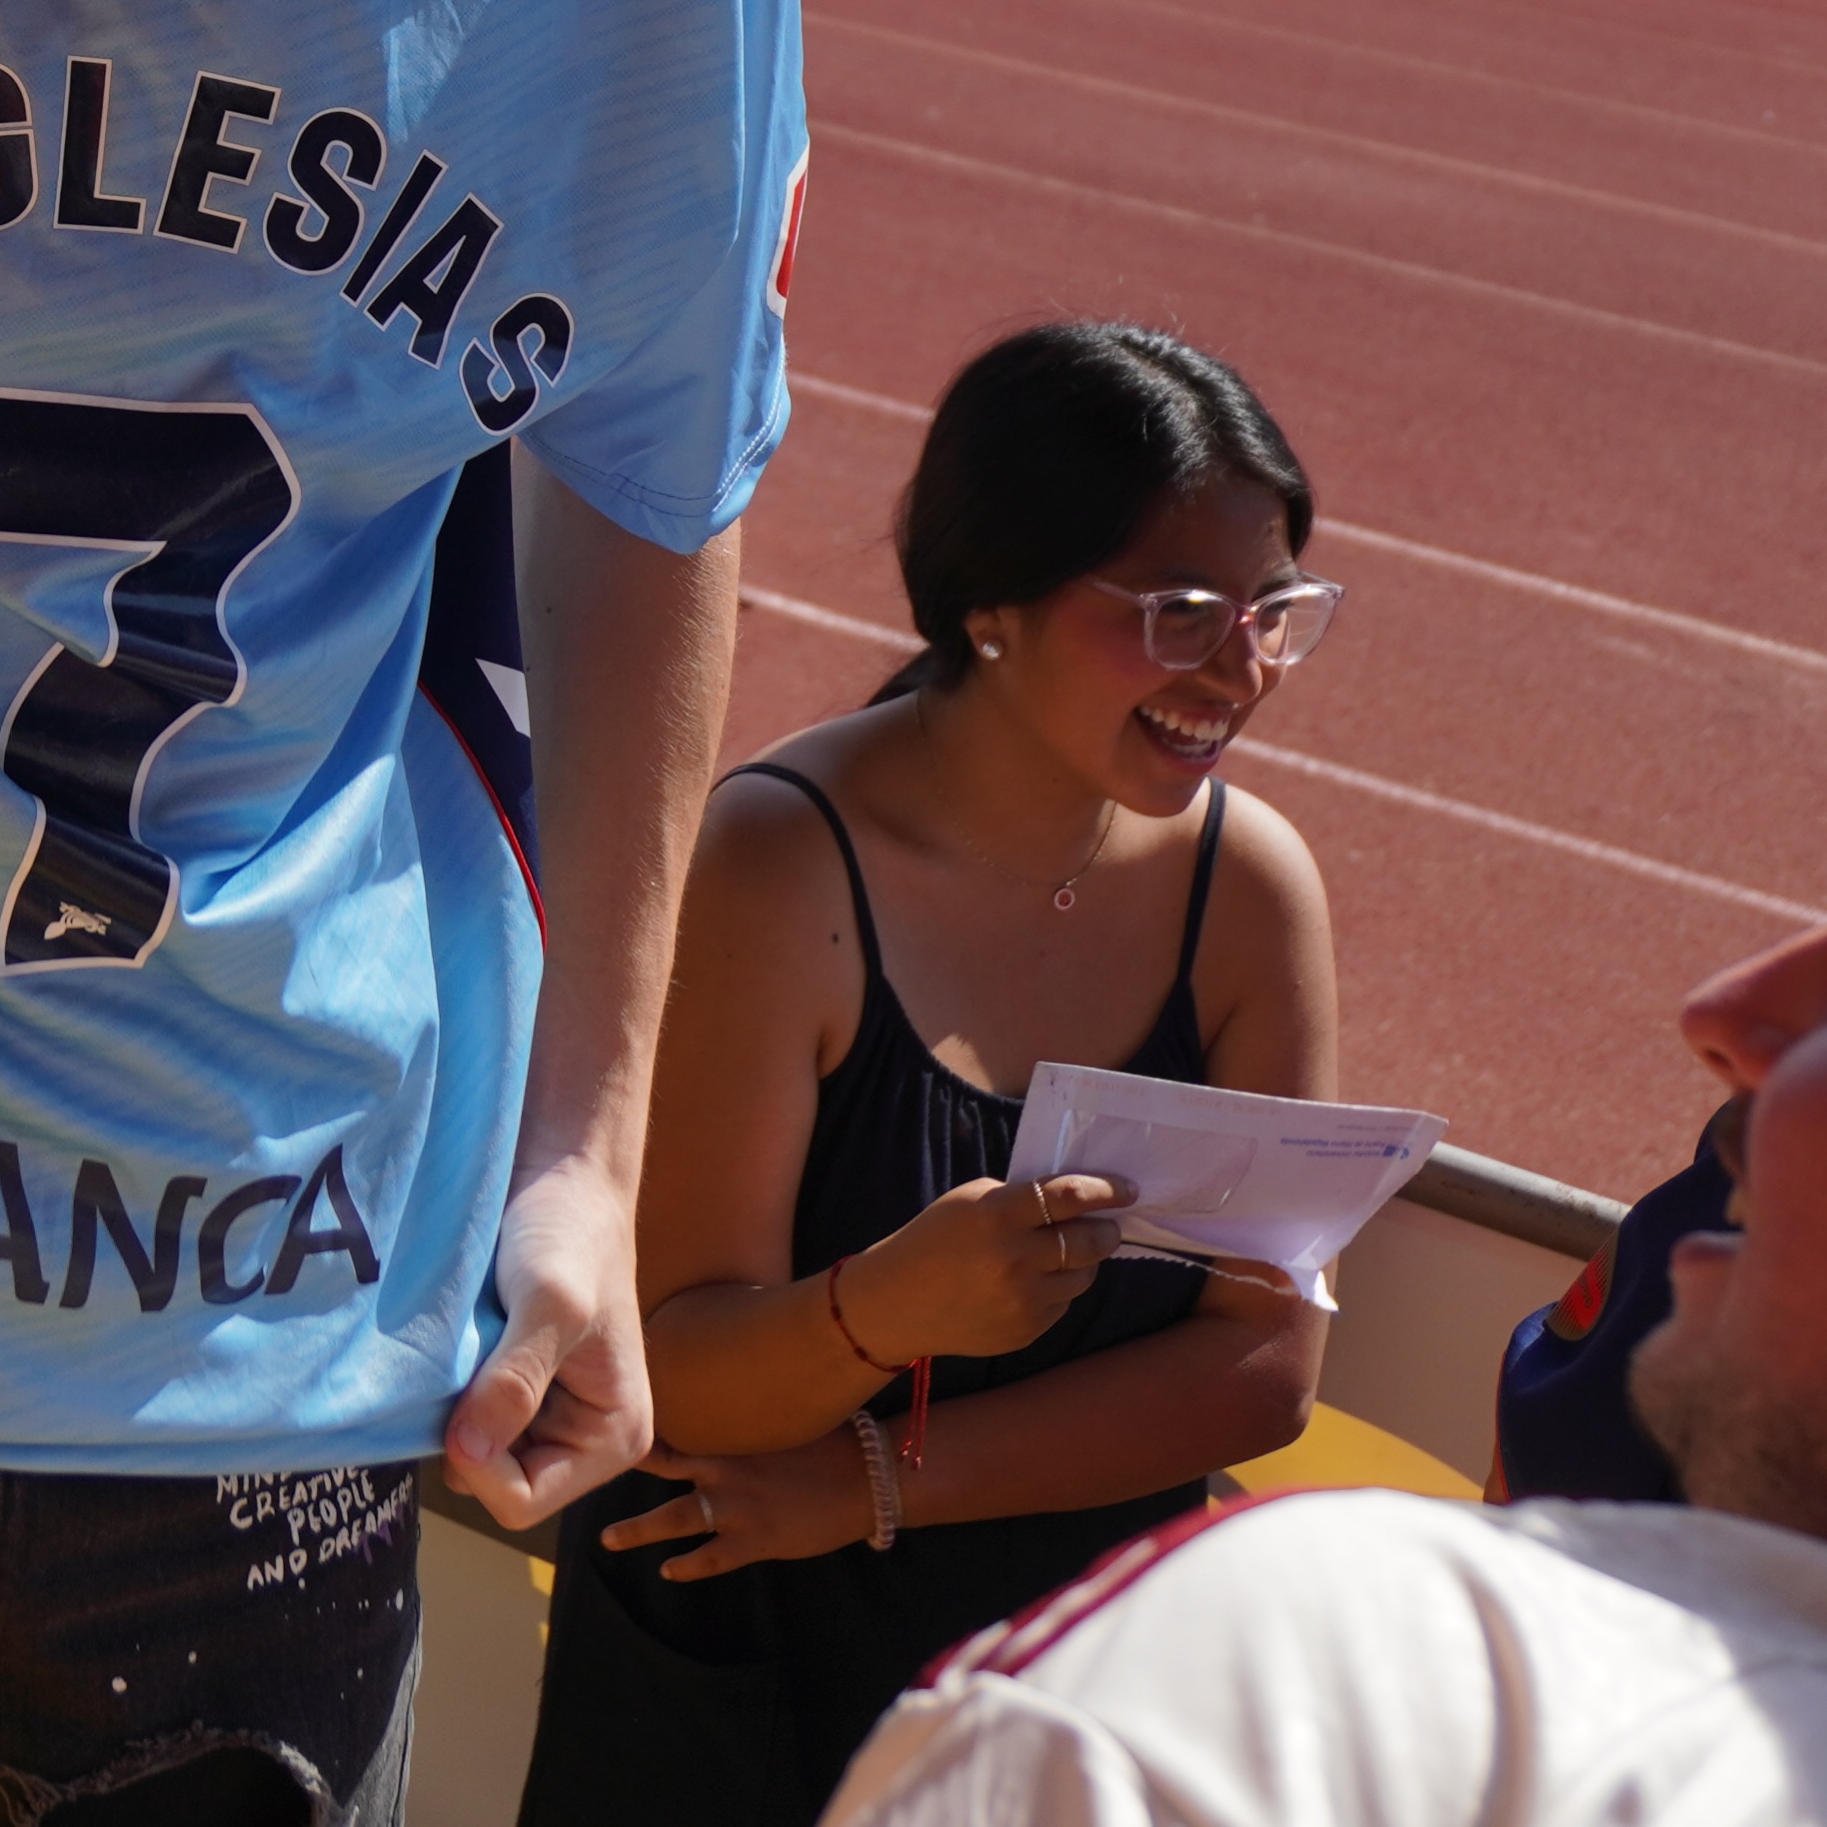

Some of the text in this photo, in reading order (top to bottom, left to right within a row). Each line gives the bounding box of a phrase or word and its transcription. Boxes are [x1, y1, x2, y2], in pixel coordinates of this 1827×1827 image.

[229, 1465, 360, 1530] CREATIVE
[287, 1469, 375, 1546] PEOPLE
[247, 1549, 308, 1591] AND
